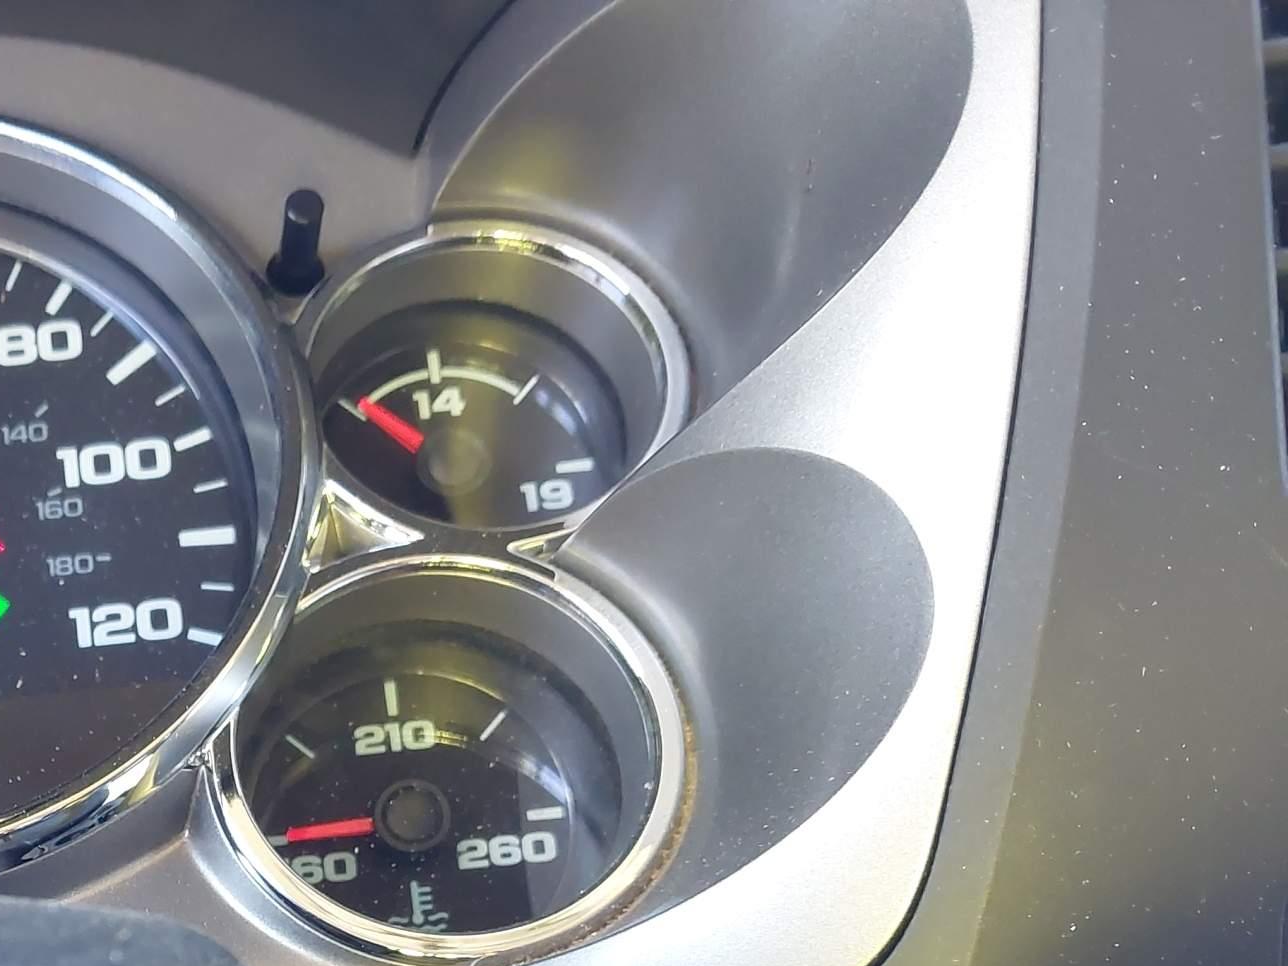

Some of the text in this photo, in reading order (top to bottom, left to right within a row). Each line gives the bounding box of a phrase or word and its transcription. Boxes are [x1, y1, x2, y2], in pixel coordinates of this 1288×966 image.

[412, 387, 466, 420] 14
[1, 423, 48, 446] 140
[56, 437, 171, 488] 100
[36, 498, 83, 520] 160
[520, 479, 574, 512] 19
[47, 554, 95, 577] 180
[68, 598, 183, 648] 120
[353, 719, 436, 757] 210
[456, 832, 556, 870] 260
